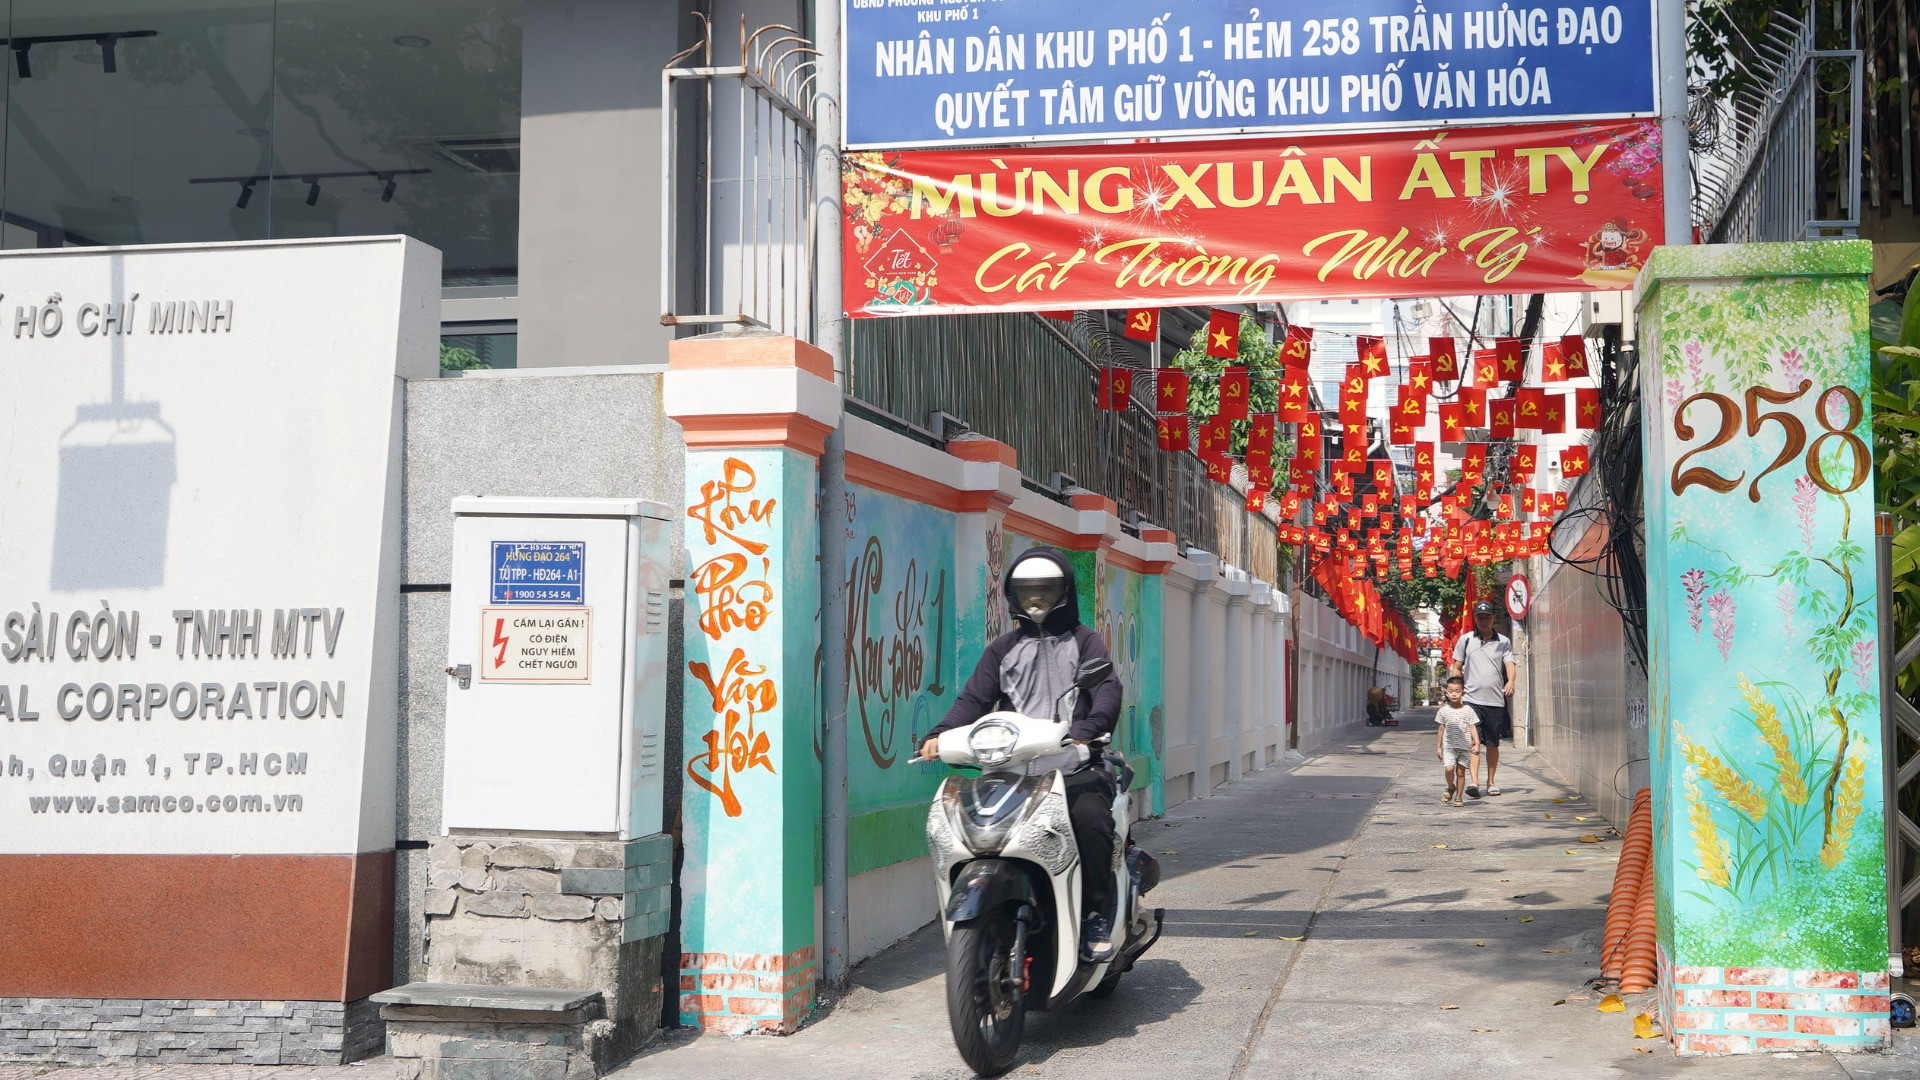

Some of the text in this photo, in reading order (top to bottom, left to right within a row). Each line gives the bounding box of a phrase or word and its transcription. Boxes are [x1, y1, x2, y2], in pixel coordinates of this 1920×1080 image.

[917, 4, 979, 23] KHU PHỐ 1
[875, 0, 1623, 78] NHÂN DÂN KHU PHỐ 1 - HẺM 258 TRẦN HƯNG ĐẠO
[934, 56, 1552, 136] QUYẾT TÂM GIỮ VỮNG KHU PHỐ VĂN HÓA
[910, 132, 1610, 220] MỪNG XUÂN ẤT TỴ
[890, 249, 912, 270] Tết
[974, 225, 1542, 299] Cát Tường Như Ý
[14, 292, 234, 339] HỒ CHÍ MINH
[1671, 379, 1872, 503] 258
[687, 457, 776, 556] Khu
[511, 568, 527, 581] TPP
[533, 568, 561, 581] HĐ264
[567, 568, 578, 581] A1
[554, 552, 571, 562] 264
[515, 591, 571, 599] 1900 54 54 54
[690, 552, 773, 641] Phố
[1, 599, 345, 662] SÀI GÒN - TNHH MTV
[513, 616, 536, 628] CẤM
[538, 619, 554, 631] LẠI
[529, 633, 568, 646] CÓ ĐIỆN
[521, 647, 549, 656] NGUY
[57, 679, 346, 722] CORPORATION
[48, 753, 127, 783] Quận
[146, 753, 172, 781] 1,
[184, 751, 308, 777] TP.HCM
[28, 792, 303, 814] www.samco.com.vn
